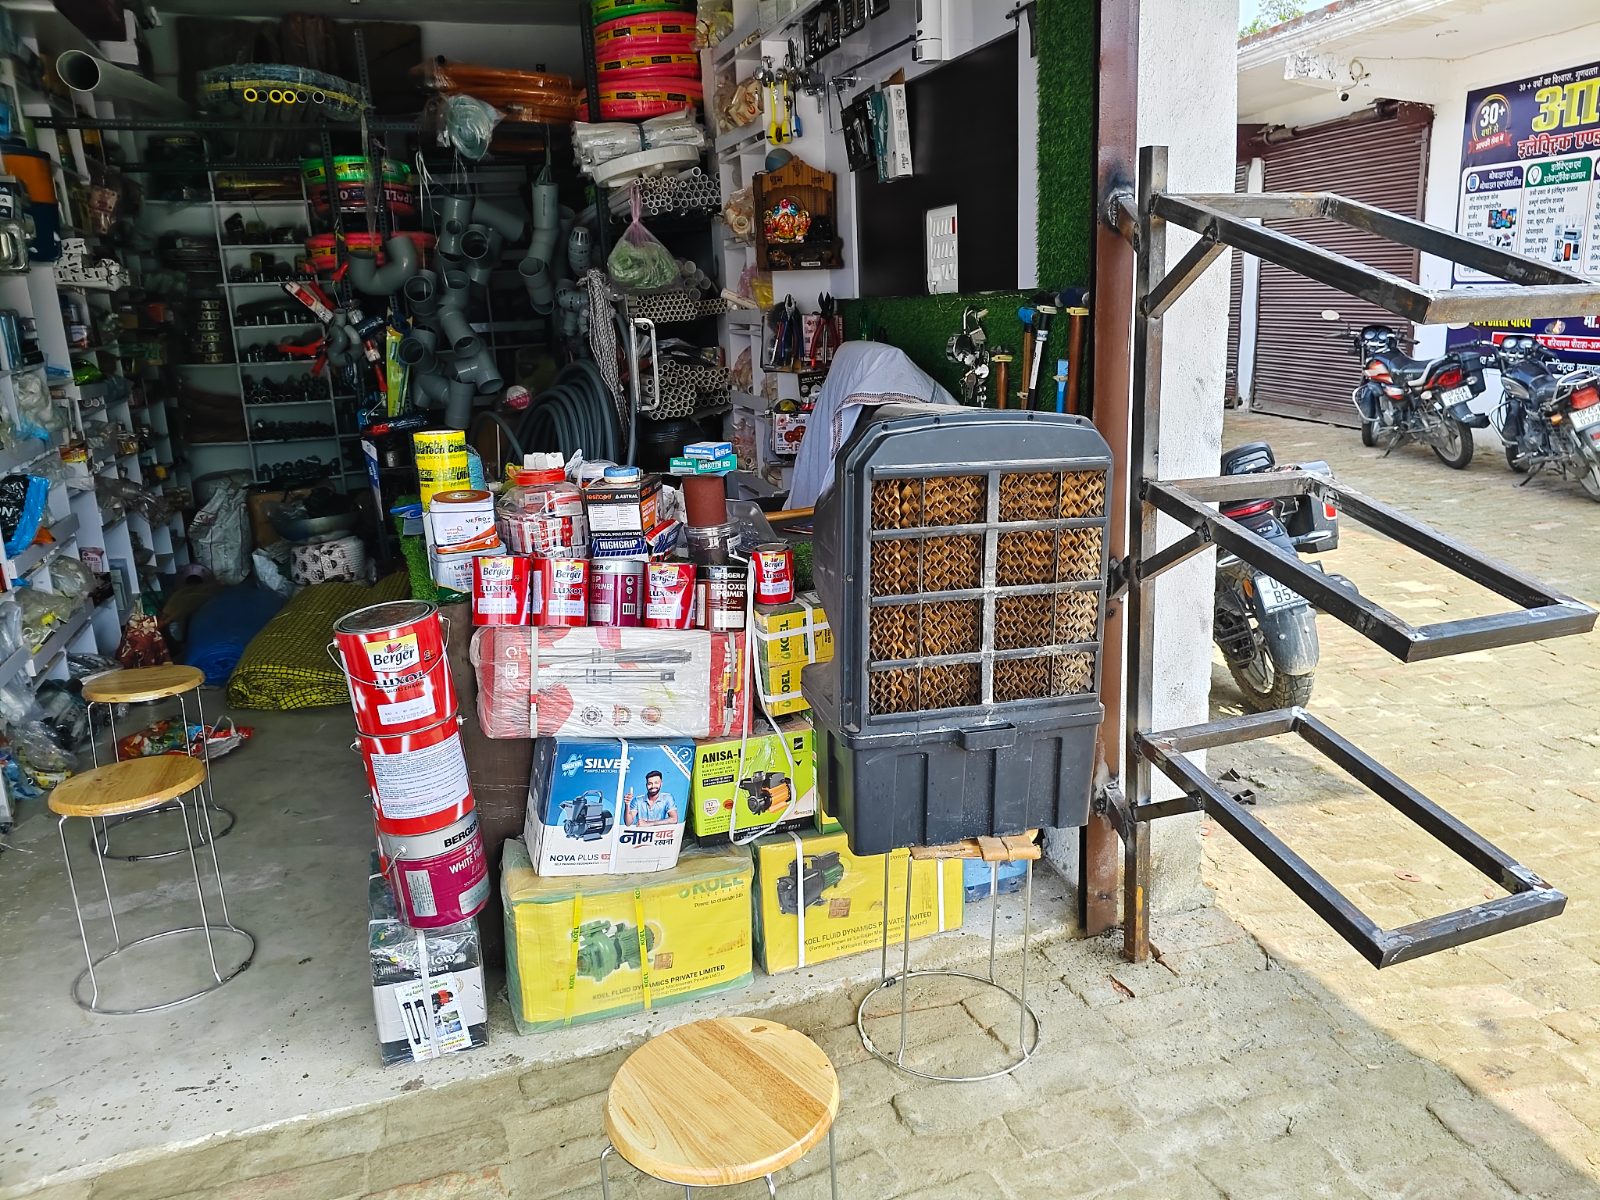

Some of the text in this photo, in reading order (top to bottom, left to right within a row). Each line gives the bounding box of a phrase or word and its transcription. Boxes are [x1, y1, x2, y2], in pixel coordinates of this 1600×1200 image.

[1480, 102, 1505, 127] 30+
[483, 566, 510, 577] Berger
[764, 561, 784, 570] Berger
[555, 569, 582, 580] Berger
[650, 574, 676, 584] Berger
[716, 590, 744, 598] PRIMER
[373, 648, 416, 666] Berger
[375, 672, 426, 690] LUXOL
[782, 670, 790, 696] OEL
[681, 750, 690, 759] 2
[444, 820, 478, 848] BERGER
[620, 830, 674, 846] नाम याद
[654, 838, 674, 846] रखना
[466, 839, 479, 856] BP
[450, 857, 474, 875] WHITE
[550, 854, 576, 862] NOVA
[693, 877, 744, 896] KOEL
[822, 931, 842, 943] FLUID
[842, 923, 878, 938] DYNAMICS
[908, 911, 932, 924] IMITED
[632, 979, 670, 992] DYAMICS
[670, 972, 698, 984] PRIVATE
[698, 964, 726, 977] LIMITED
